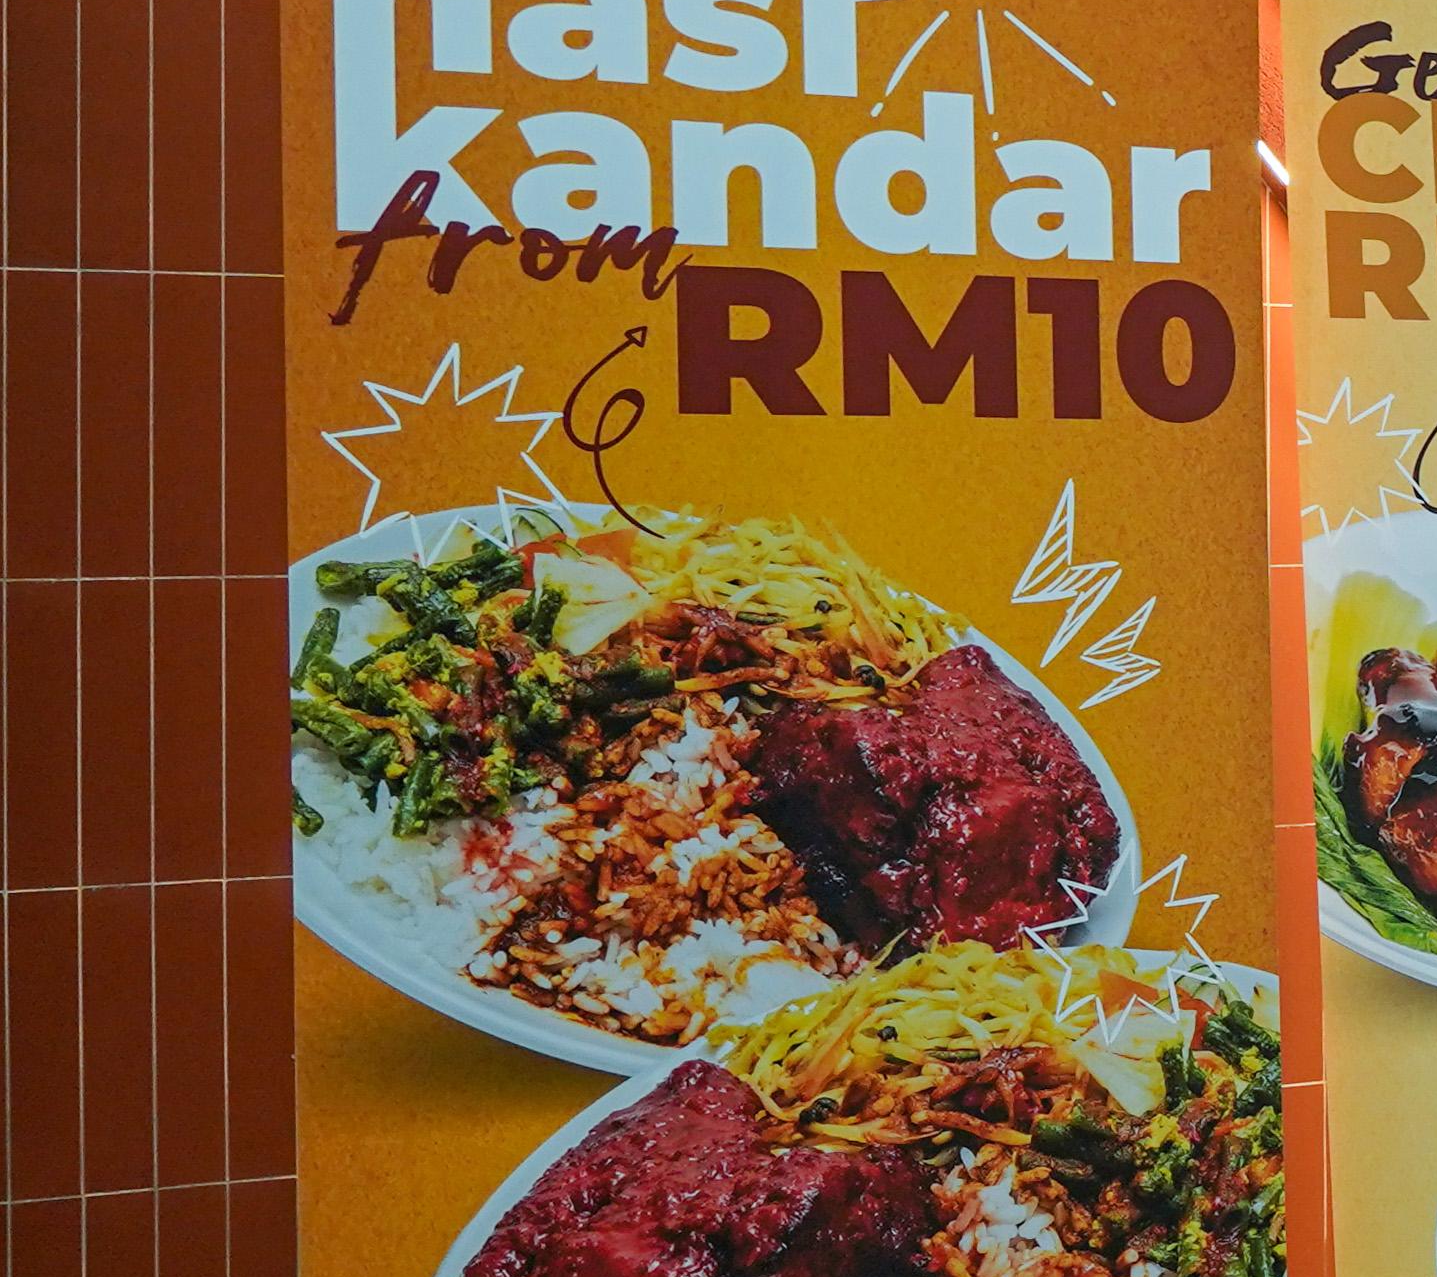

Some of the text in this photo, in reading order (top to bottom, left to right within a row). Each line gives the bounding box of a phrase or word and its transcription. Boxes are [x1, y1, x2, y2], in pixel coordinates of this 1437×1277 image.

[330, 170, 692, 325] from
[333, 92, 1211, 263] kandar
[676, 266, 1236, 420] RM10
